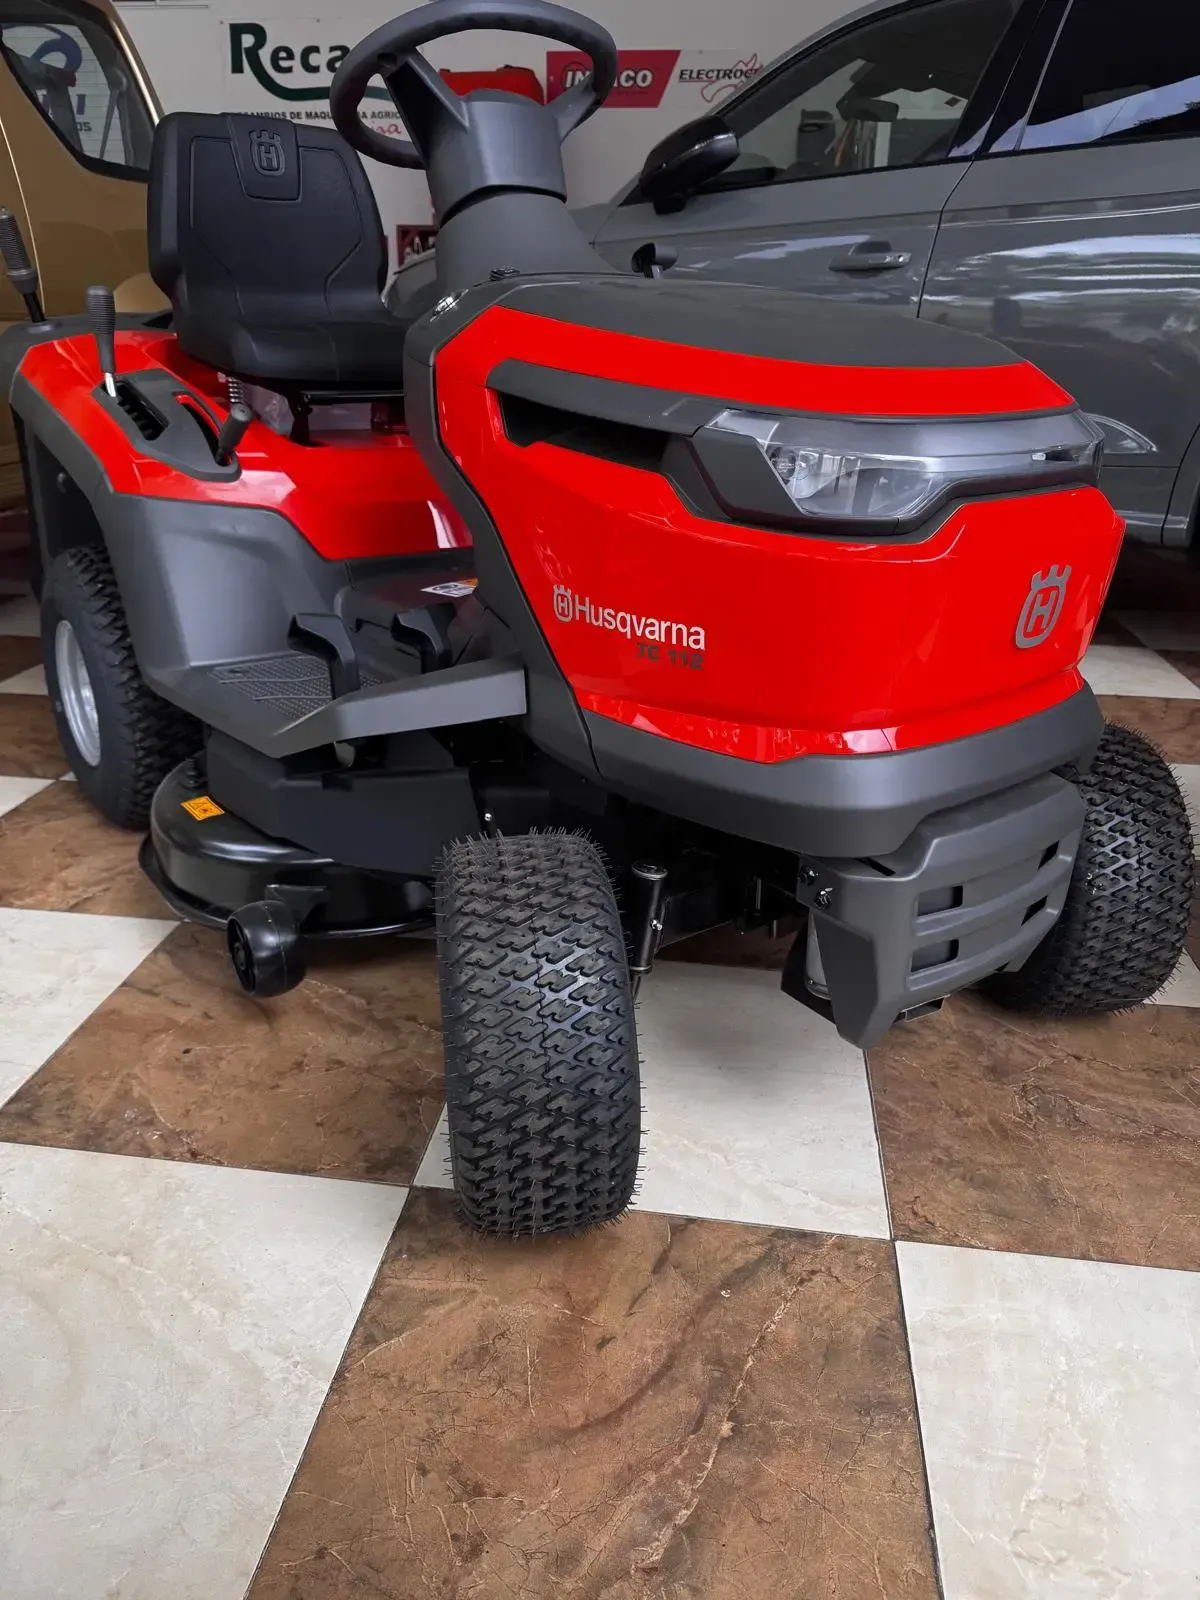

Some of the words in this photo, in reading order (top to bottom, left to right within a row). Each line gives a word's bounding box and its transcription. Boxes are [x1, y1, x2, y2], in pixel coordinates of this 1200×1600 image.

[229, 22, 351, 75] Reca
[290, 111, 302, 120] DE
[575, 594, 705, 651] Husqvarna
[637, 643, 660, 662] TC
[668, 649, 704, 670] 112
